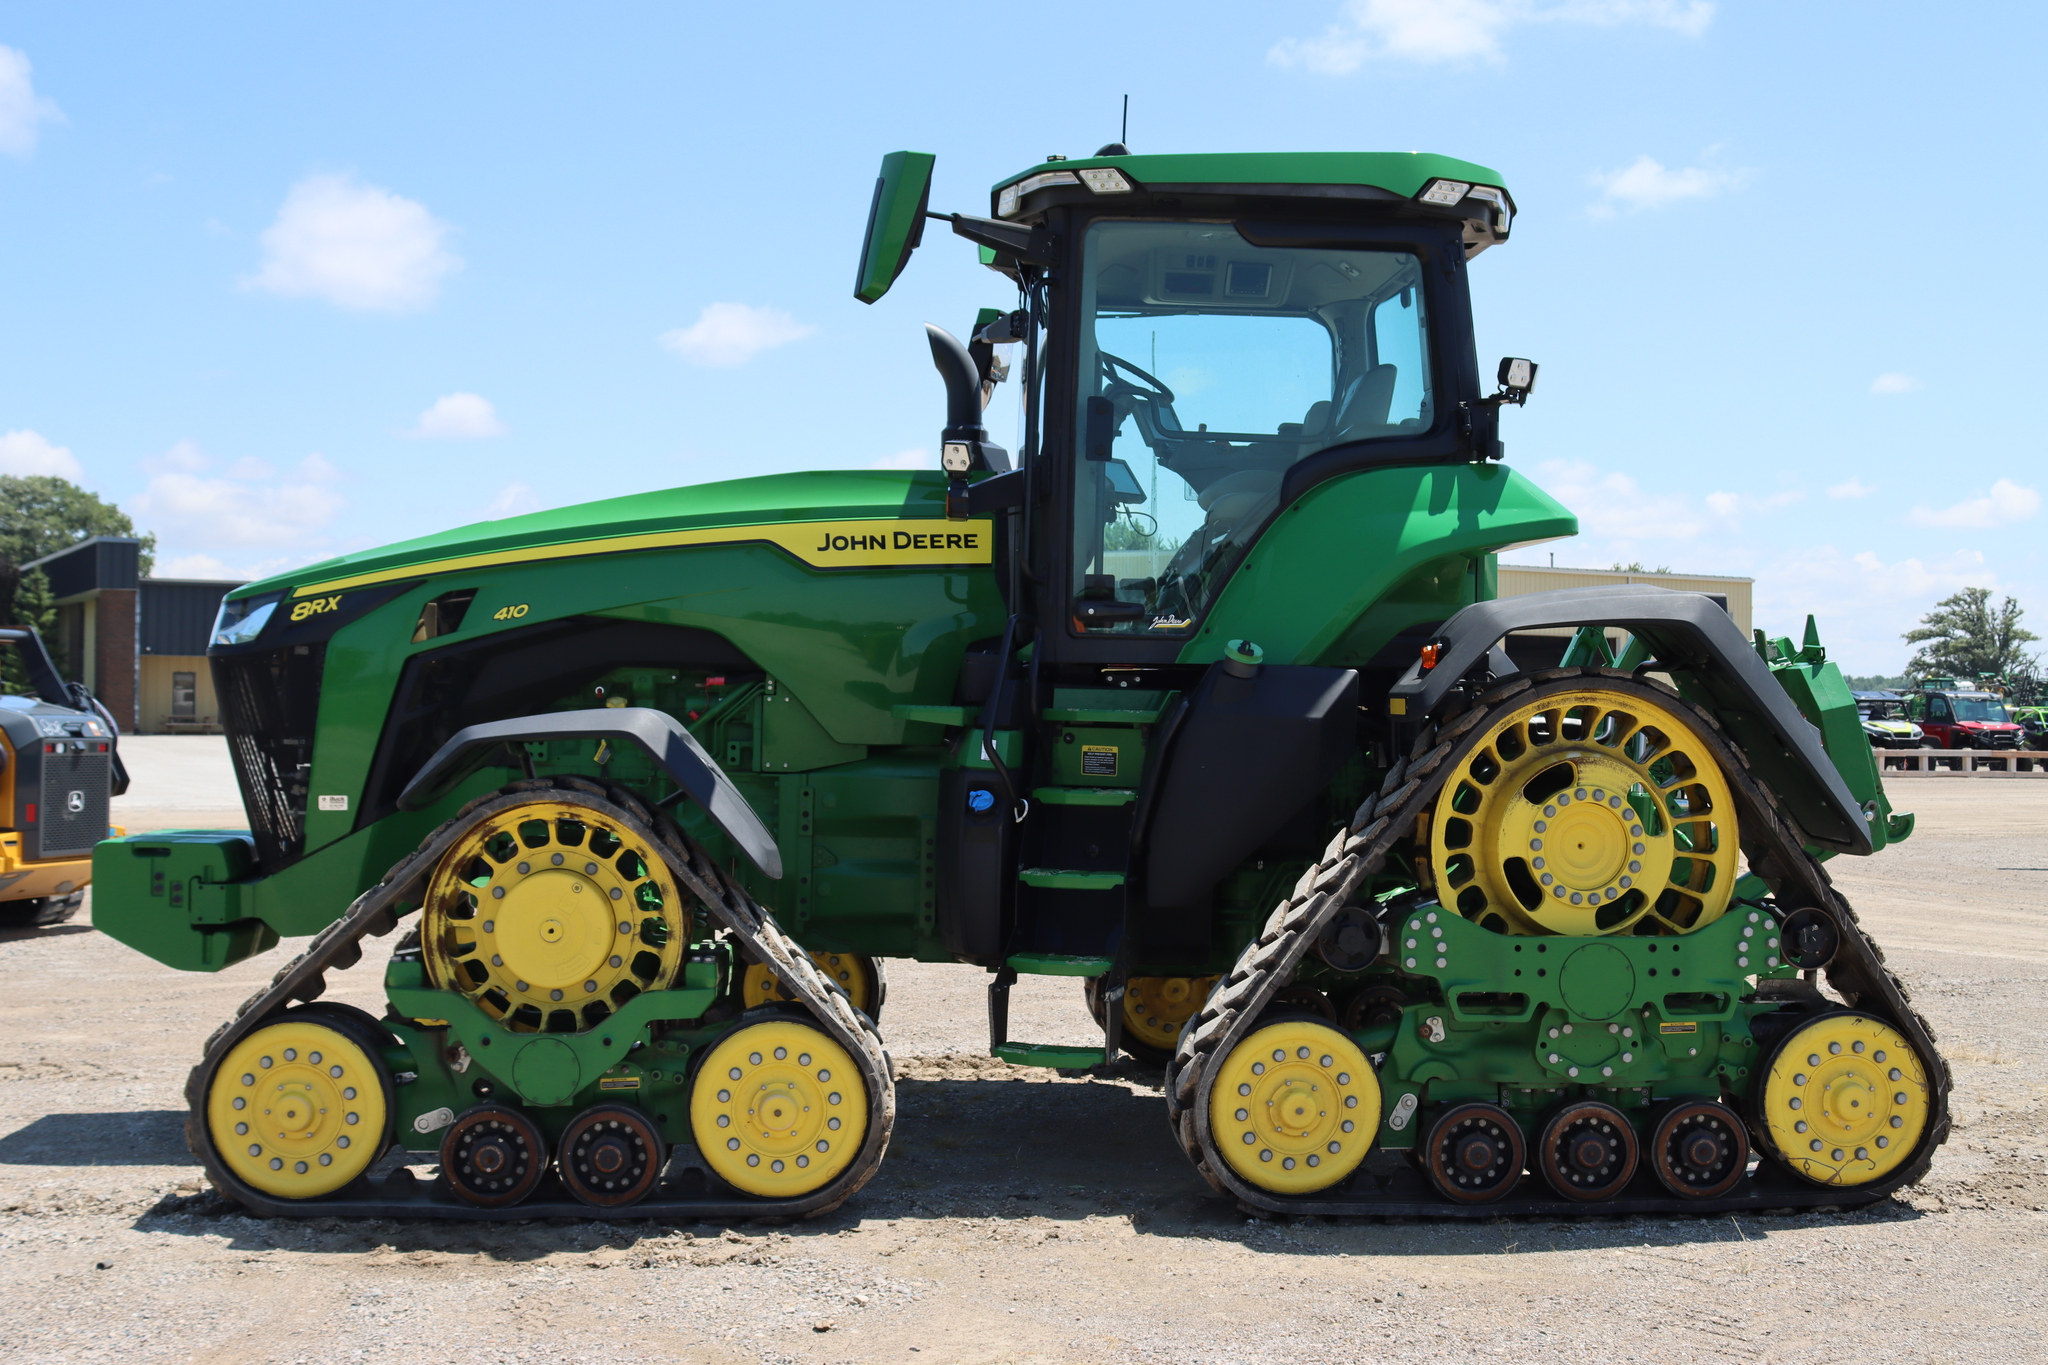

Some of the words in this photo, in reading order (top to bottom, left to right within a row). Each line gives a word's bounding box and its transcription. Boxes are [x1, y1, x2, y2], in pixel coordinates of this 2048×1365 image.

[817, 533, 886, 552] JOHN
[893, 531, 979, 550] DEERE
[290, 595, 343, 622] 8RX
[493, 603, 530, 621] 410
[1148, 616, 1168, 630] John
